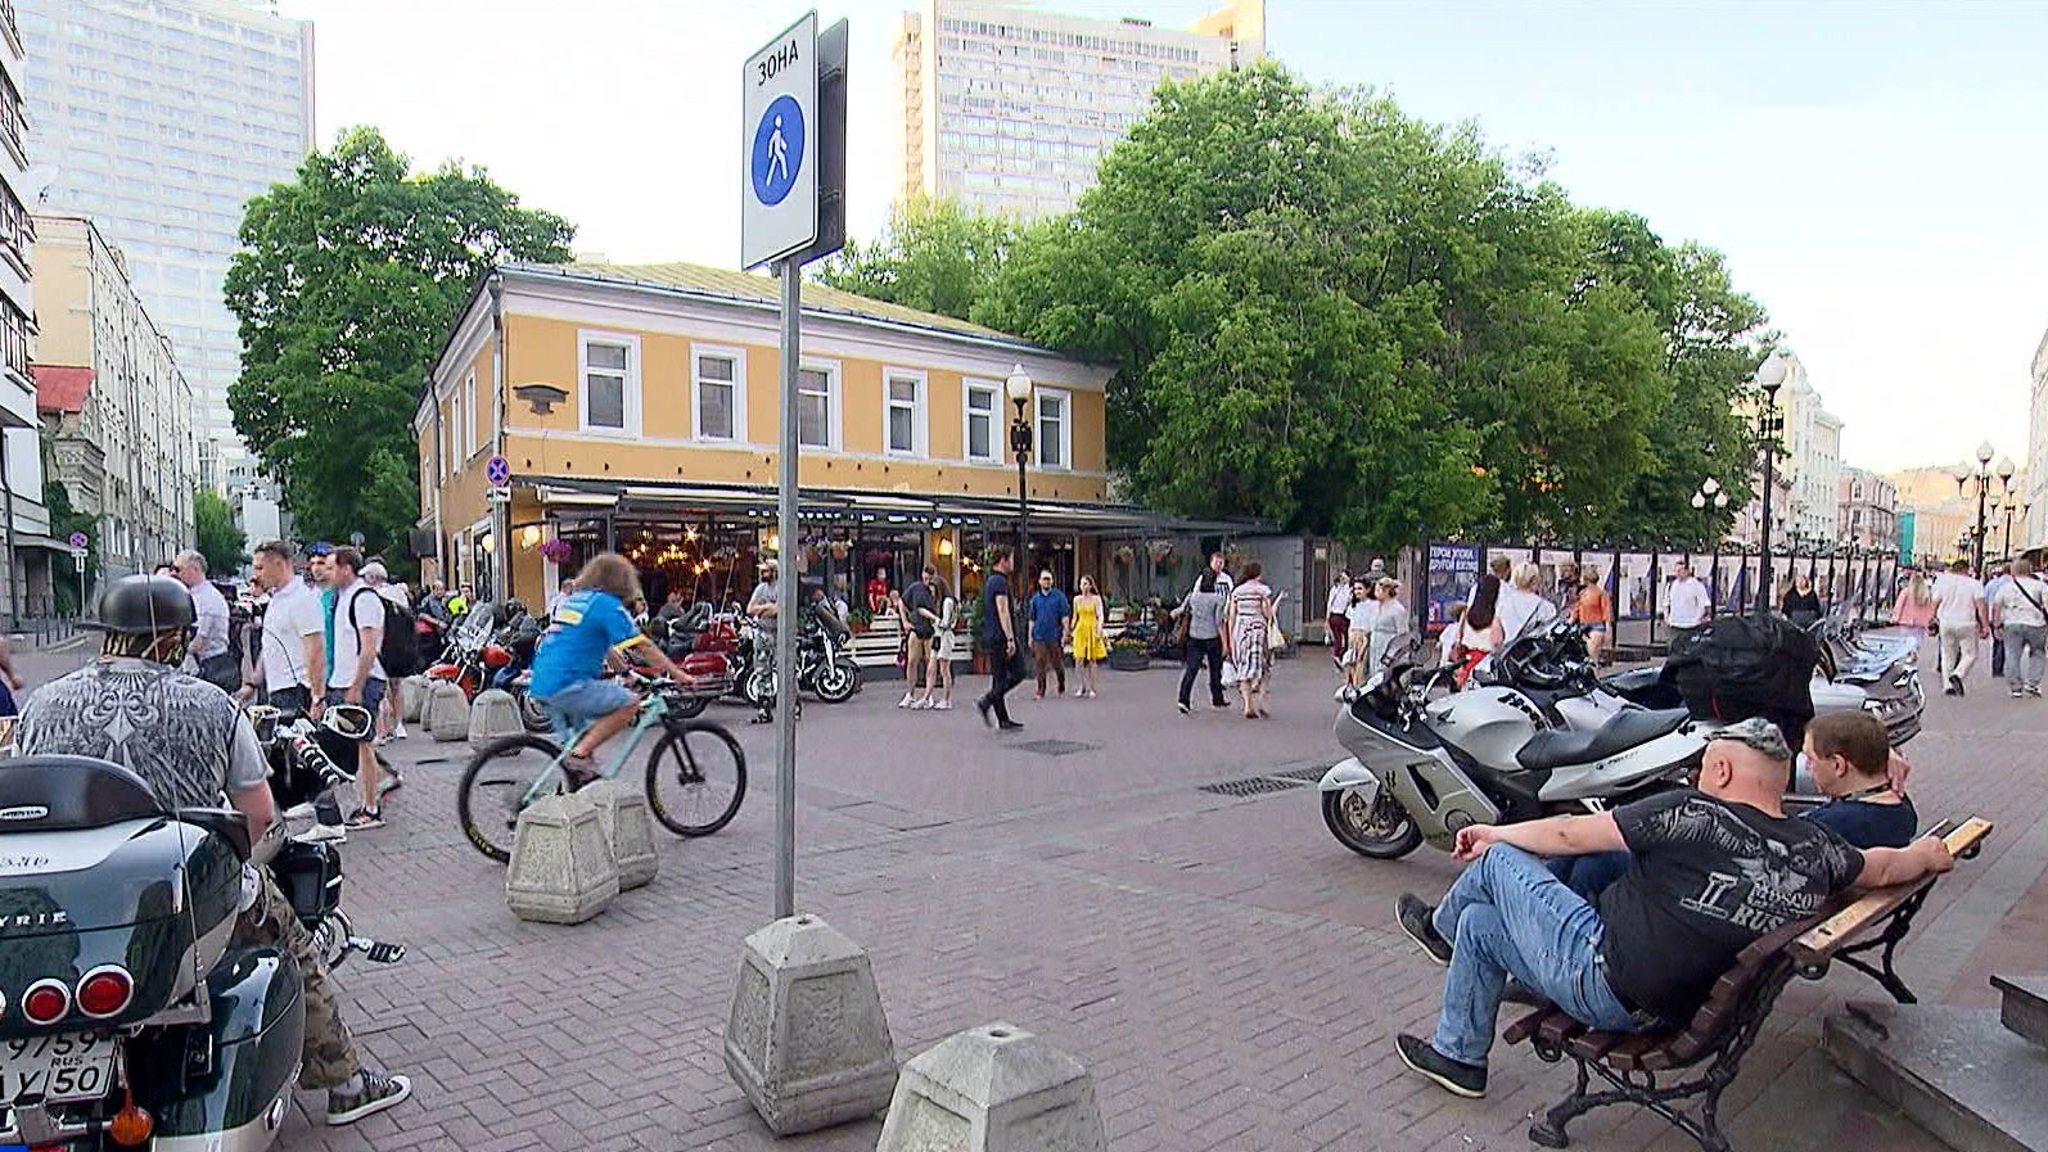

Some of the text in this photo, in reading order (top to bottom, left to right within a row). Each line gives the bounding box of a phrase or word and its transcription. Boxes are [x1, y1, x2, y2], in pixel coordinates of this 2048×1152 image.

[757, 39, 799, 87] ЗОНА
[51, 1056, 83, 1068] RUS
[53, 1065, 100, 1094] 50
